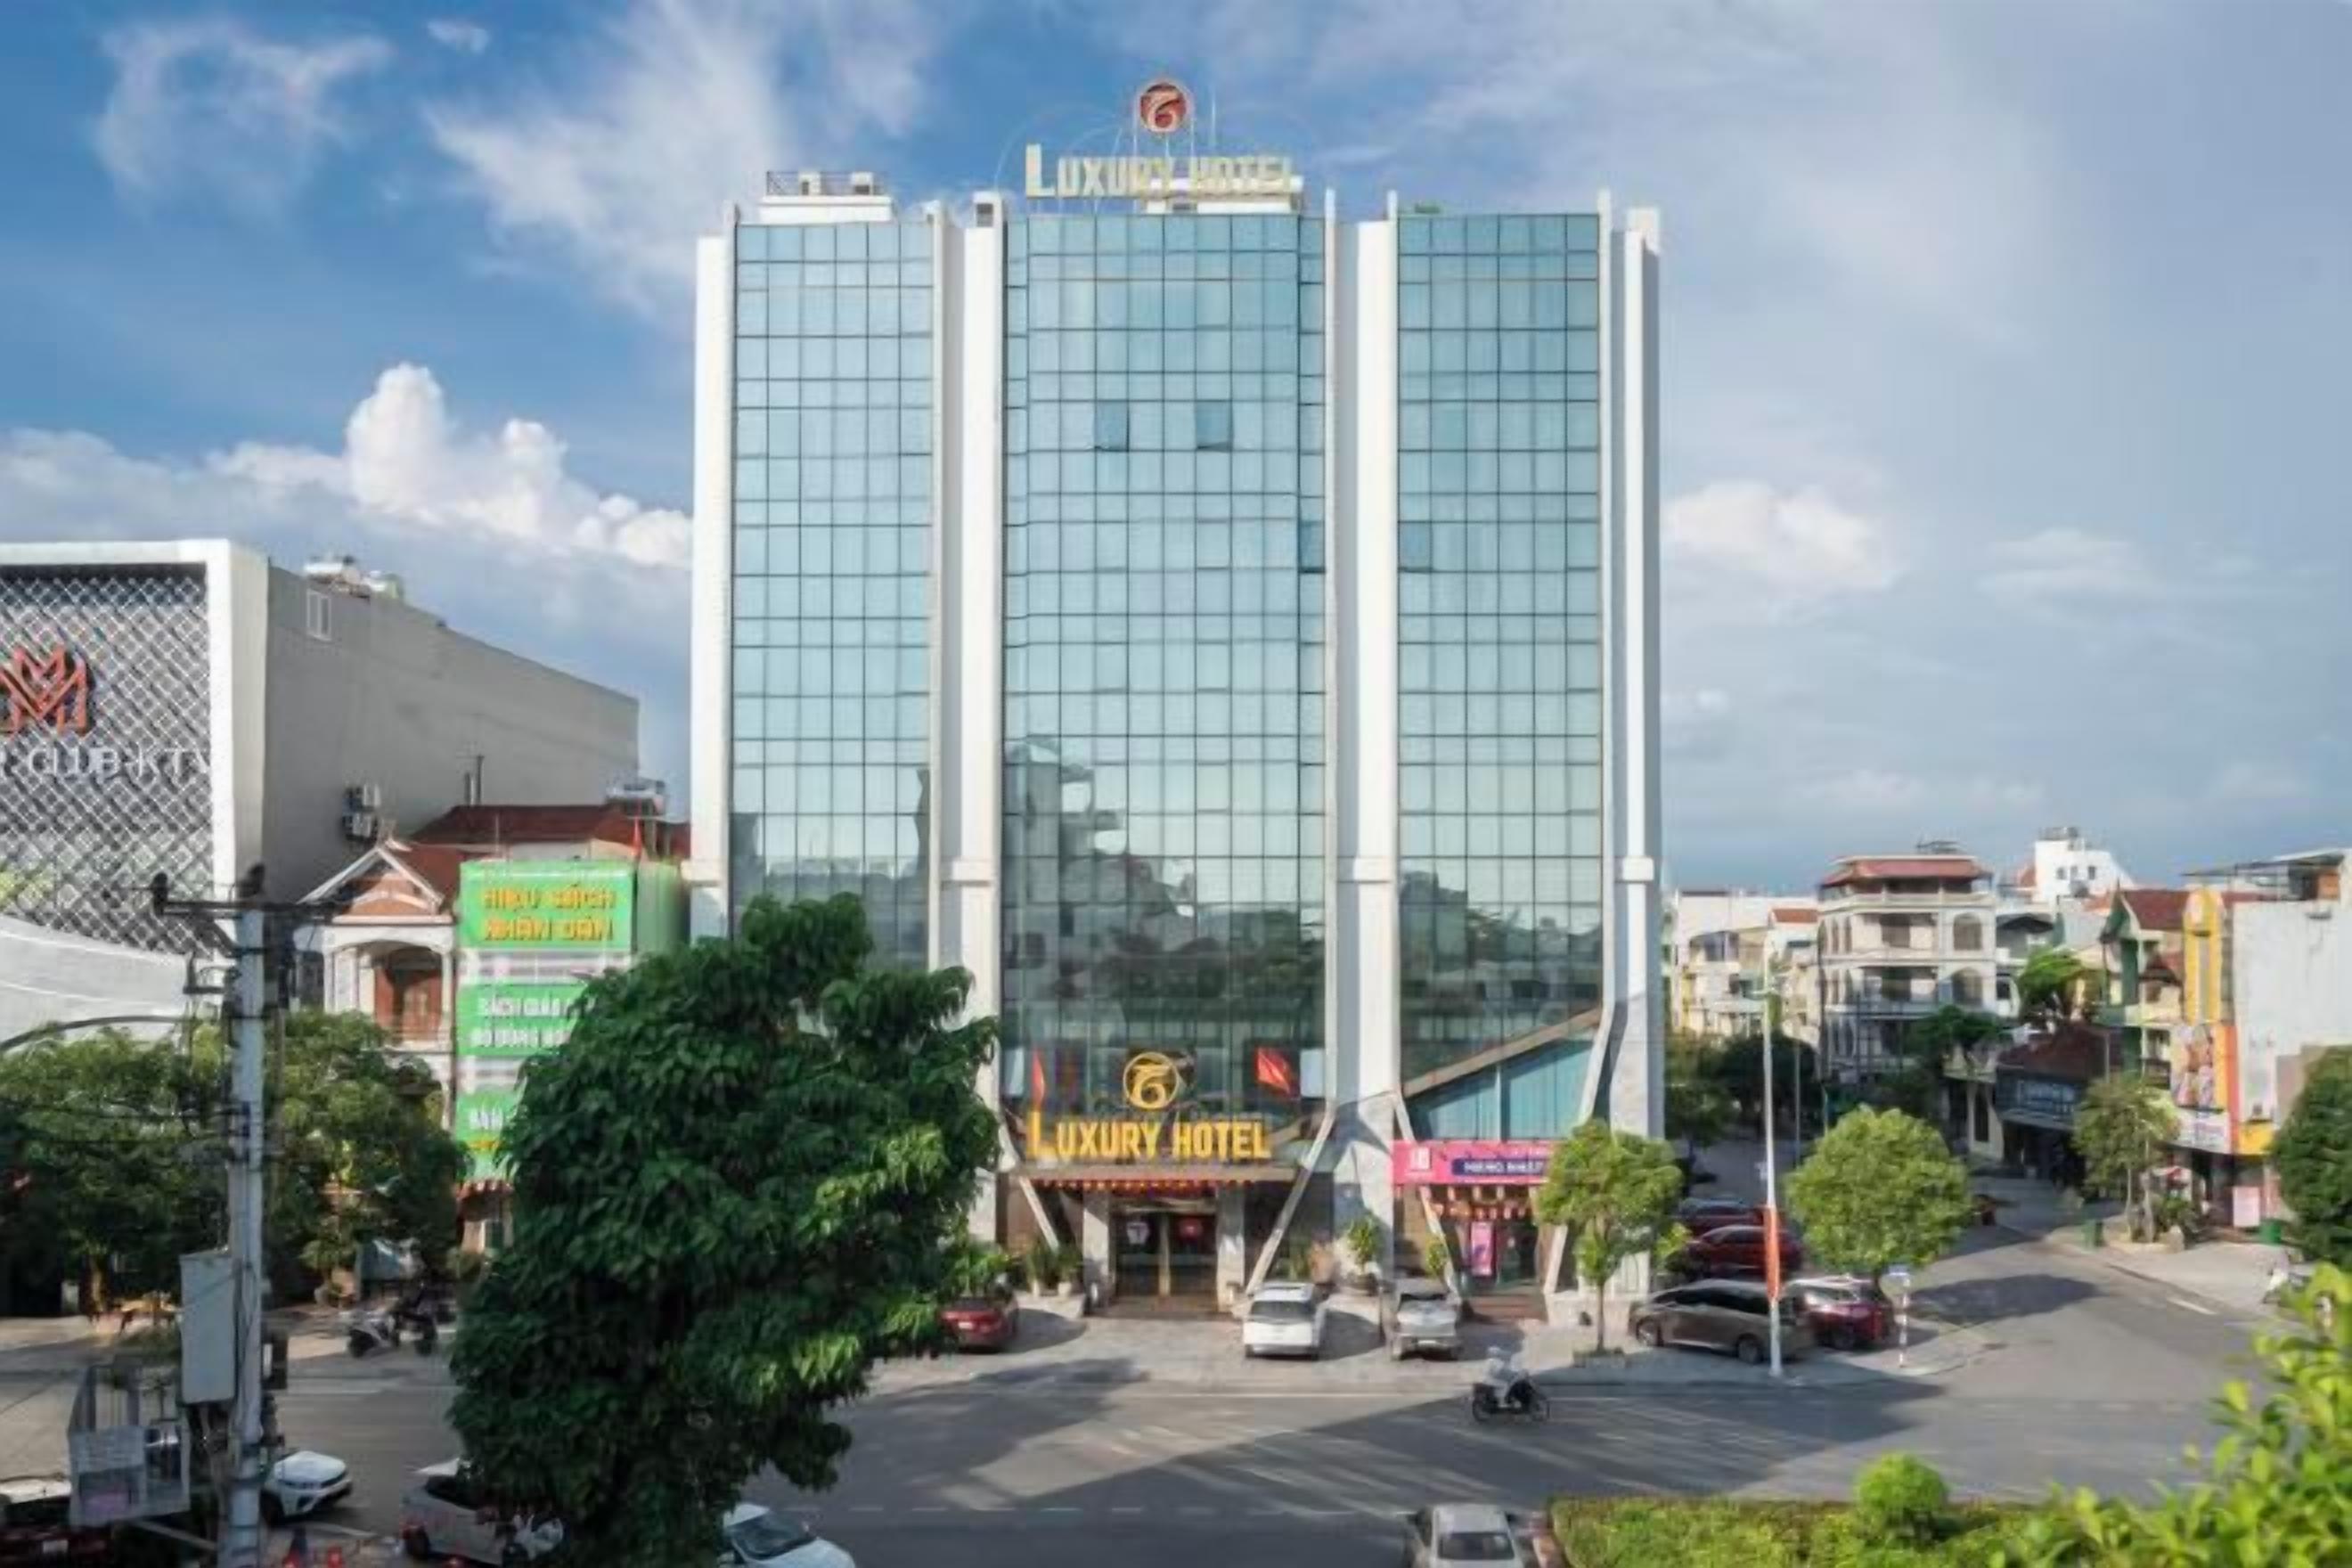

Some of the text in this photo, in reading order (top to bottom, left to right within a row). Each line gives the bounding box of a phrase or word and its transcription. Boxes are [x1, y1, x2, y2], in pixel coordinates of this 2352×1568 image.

[1025, 143, 1175, 197] LUXURY
[1028, 1111, 1272, 1158] LUXURY HOTEL
